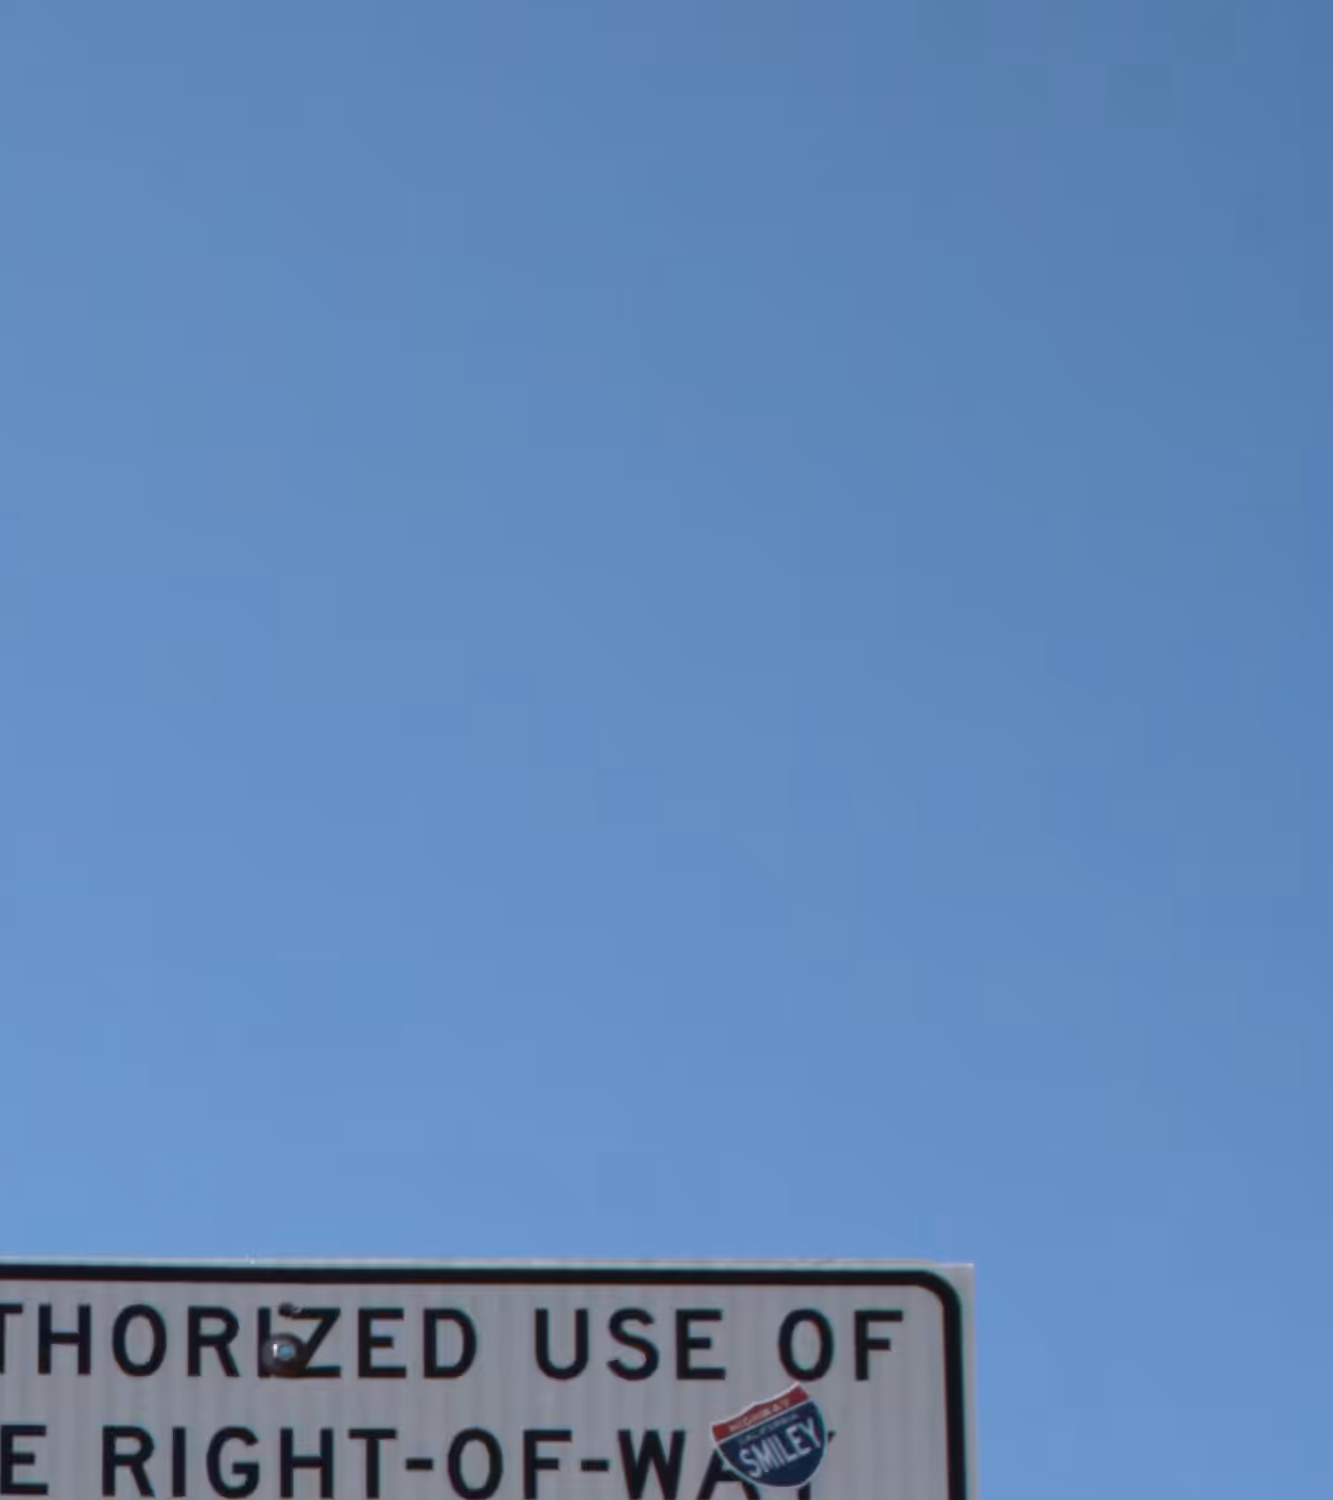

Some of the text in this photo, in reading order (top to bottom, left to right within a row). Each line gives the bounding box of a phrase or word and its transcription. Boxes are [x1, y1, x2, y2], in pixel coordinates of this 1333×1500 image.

[536, 1308, 725, 1381] USE
[777, 1309, 903, 1382] OF
[739, 1417, 821, 1478] SMILEY
